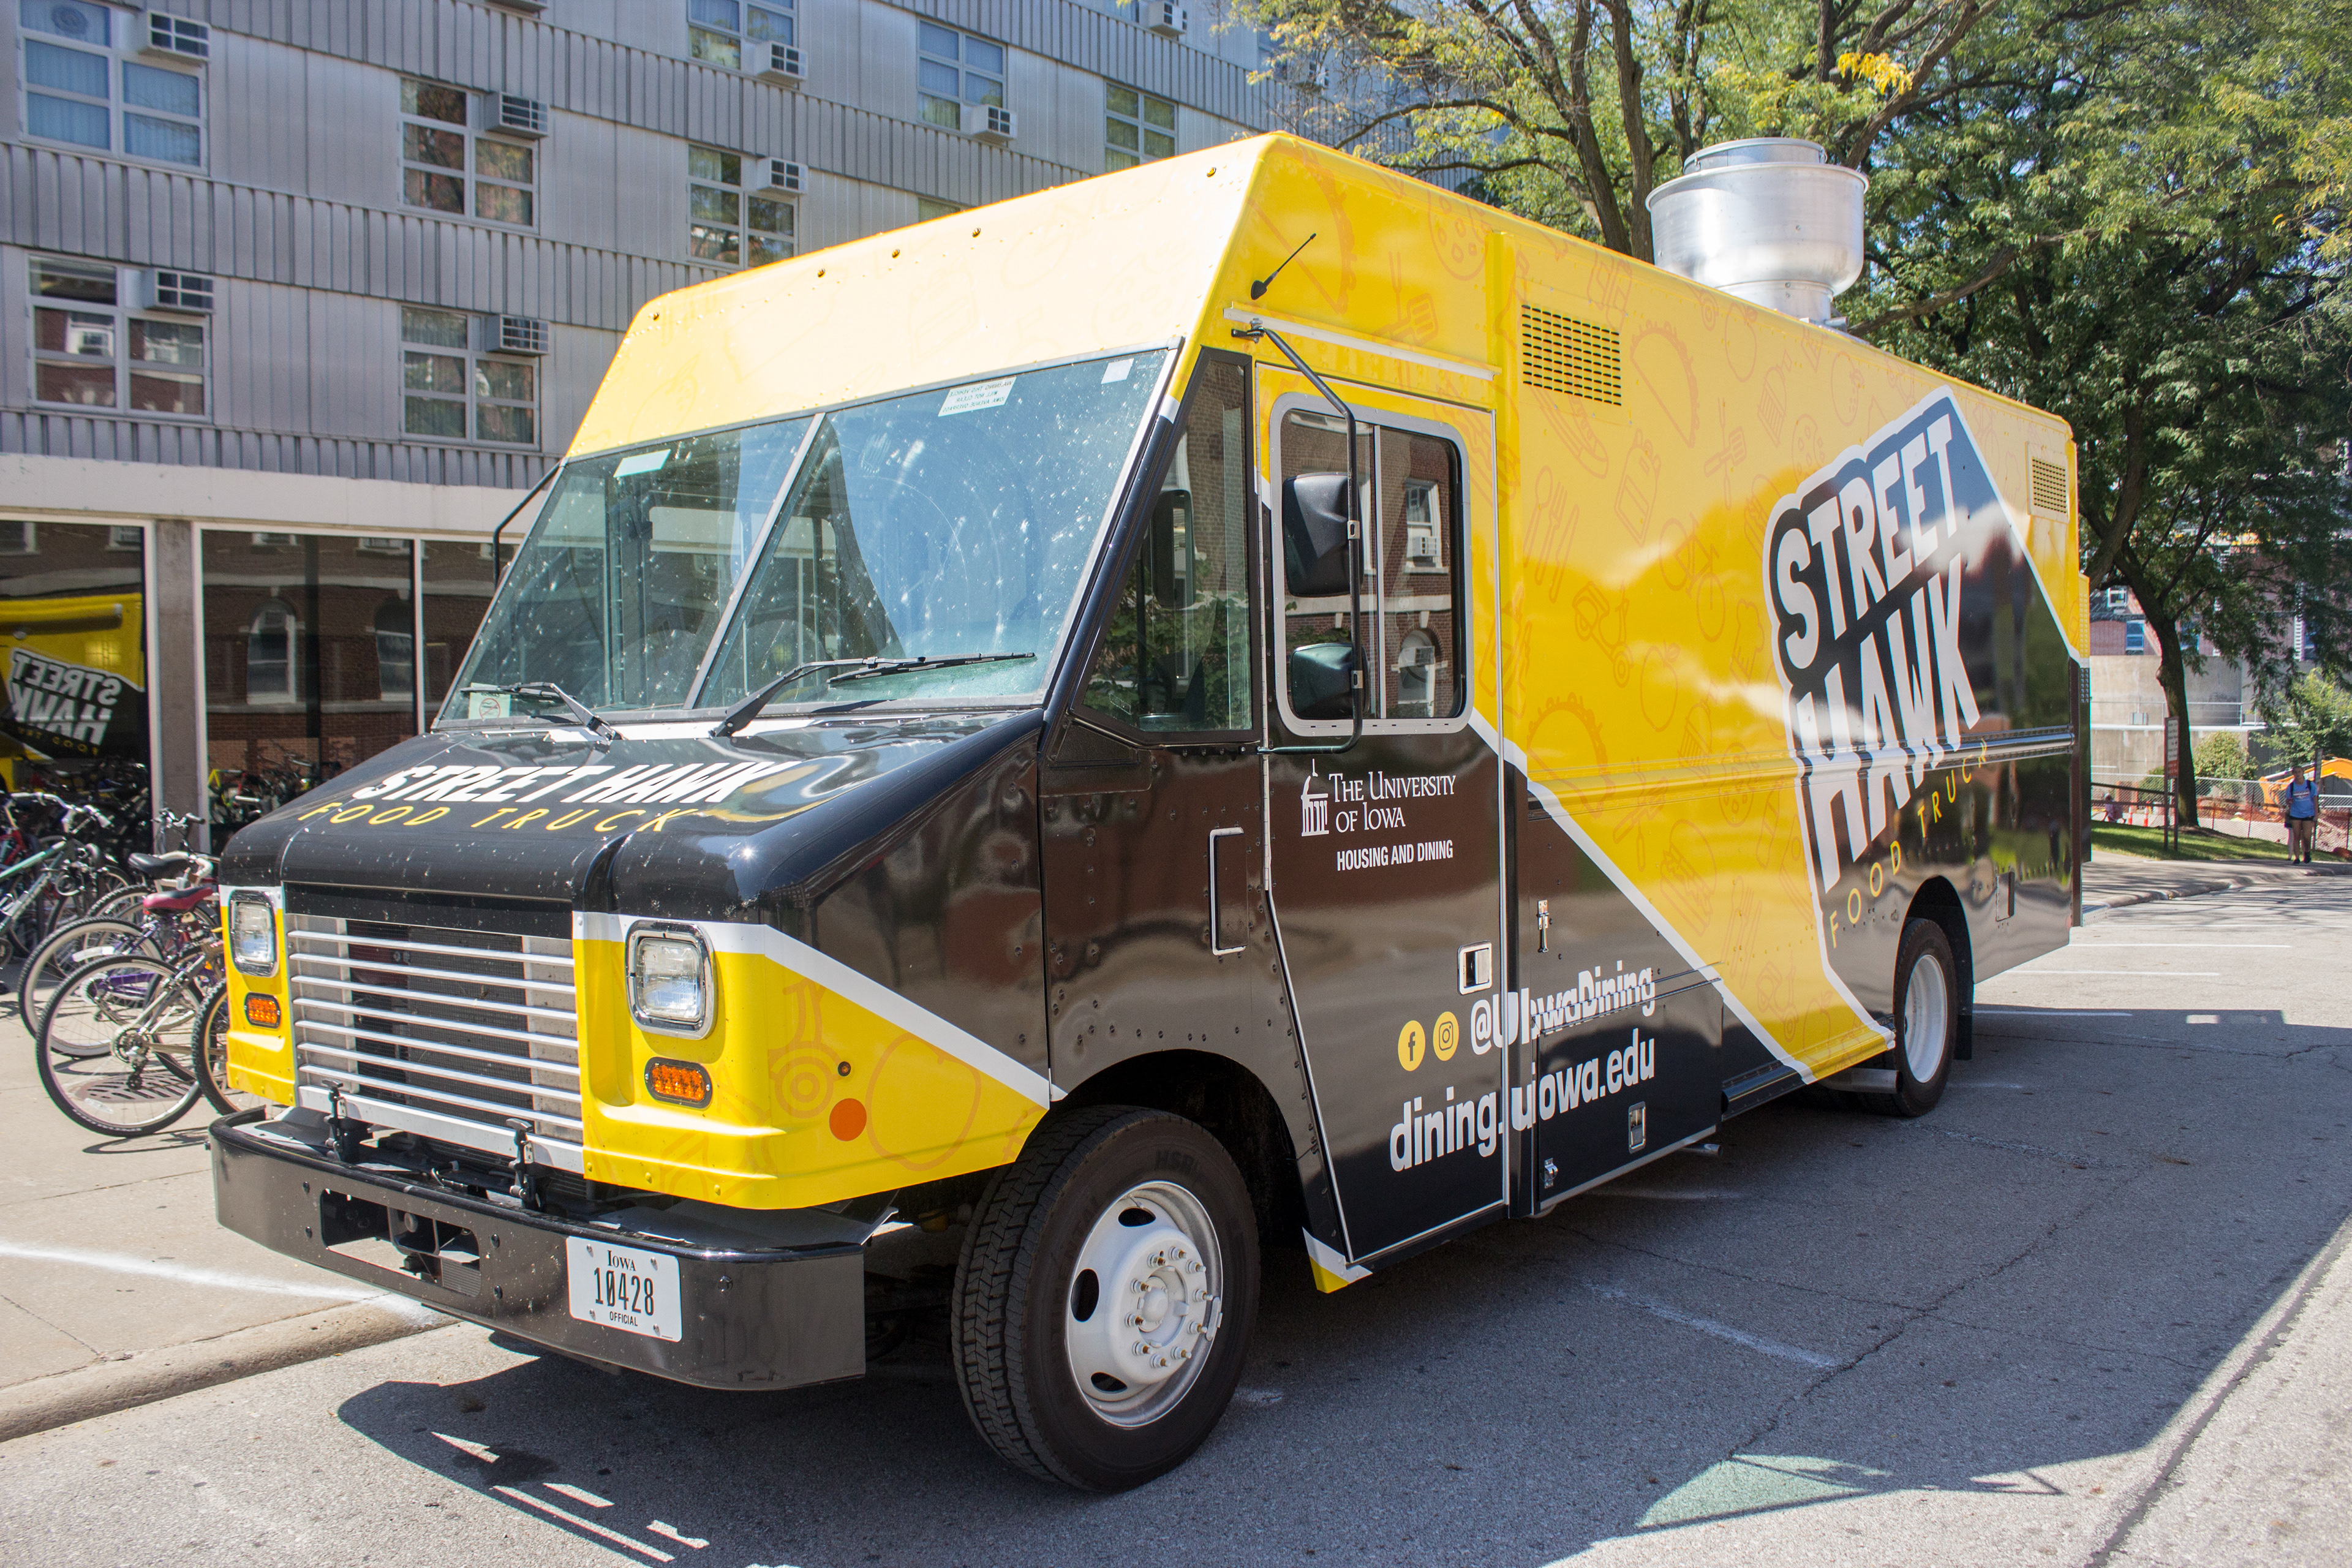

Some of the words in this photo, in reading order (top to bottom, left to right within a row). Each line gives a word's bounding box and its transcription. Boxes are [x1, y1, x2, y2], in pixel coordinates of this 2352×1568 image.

[1776, 413, 1957, 669] STREET
[1796, 552, 1980, 894] HAWK
[352, 765, 616, 803] STREET
[559, 761, 803, 804] HAWK
[297, 802, 451, 826] FOOD
[470, 807, 699, 832] TRUCK
[1336, 846, 1389, 872] HOUSING
[1391, 843, 1414, 865] AND
[1417, 839, 1453, 862] DINING
[1829, 840, 1902, 949] FOOD
[1917, 737, 1988, 839] TRUCK
[1389, 1027, 1655, 1172] dining.uiowa.edu
[607, 1250, 637, 1272] IOWA
[593, 1267, 655, 1317] 10428
[609, 1310, 639, 1327] OFFICIAL
